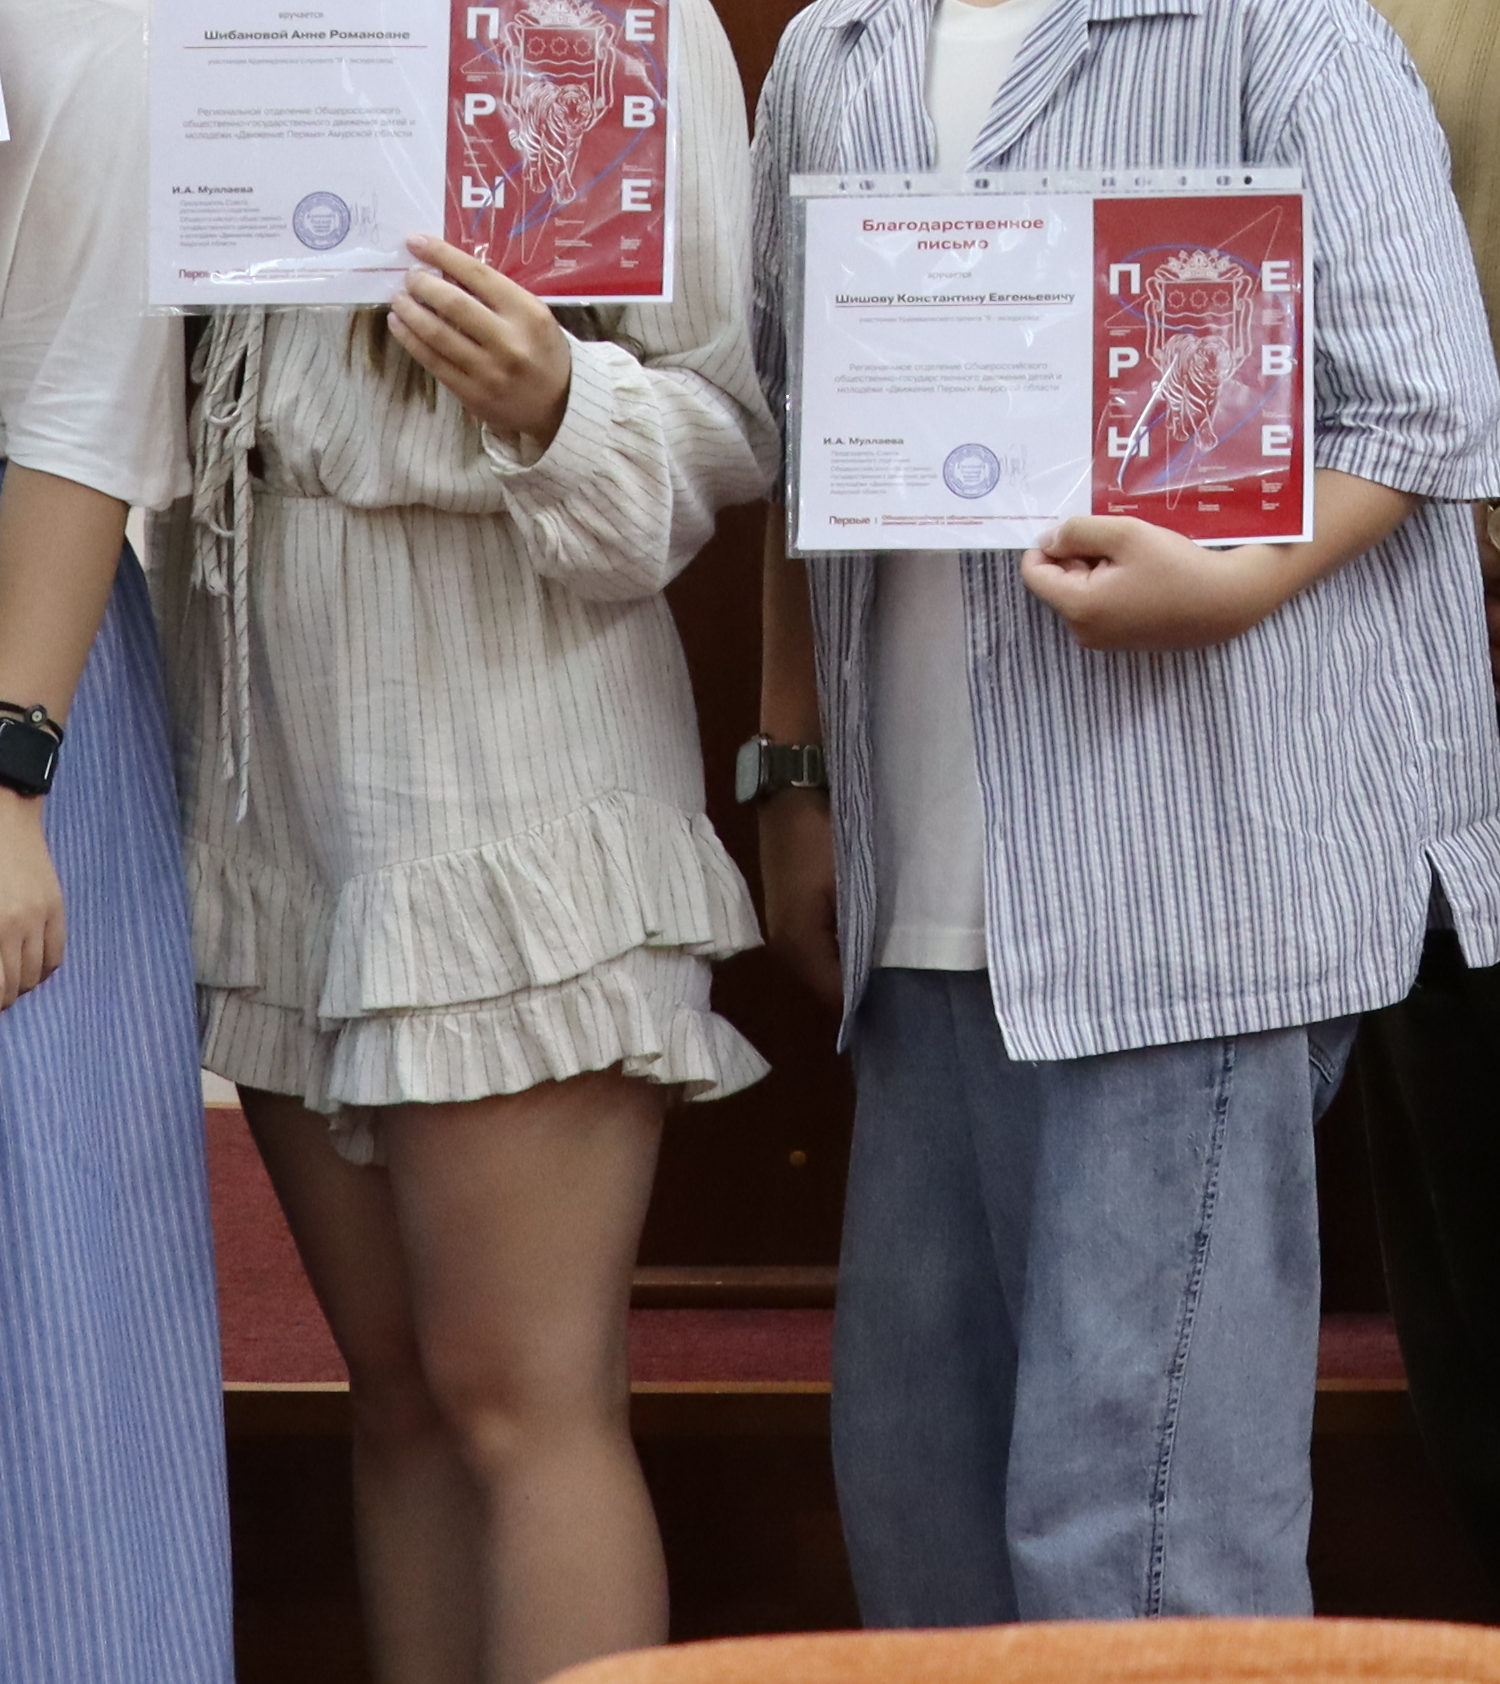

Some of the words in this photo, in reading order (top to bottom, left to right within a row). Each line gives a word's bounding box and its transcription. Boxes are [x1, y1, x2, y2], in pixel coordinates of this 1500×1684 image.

[203, 29, 288, 40] Шибановой
[291, 29, 326, 40] Анне
[467, 7, 498, 38] П
[626, 9, 655, 42] Е
[464, 93, 496, 125] Р
[624, 96, 656, 128] В
[462, 176, 504, 208] Ы
[622, 178, 651, 211] Е
[863, 216, 1044, 233] Благодарственное
[917, 237, 989, 251] письмо
[1109, 263, 1140, 293] П
[1262, 260, 1291, 292] Е
[896, 292, 986, 305] Константину
[988, 290, 1075, 303] Евгеньевичу
[1108, 347, 1140, 378] Р
[1261, 344, 1294, 376] В
[1107, 425, 1149, 458] Ы
[1261, 424, 1291, 456] Е
